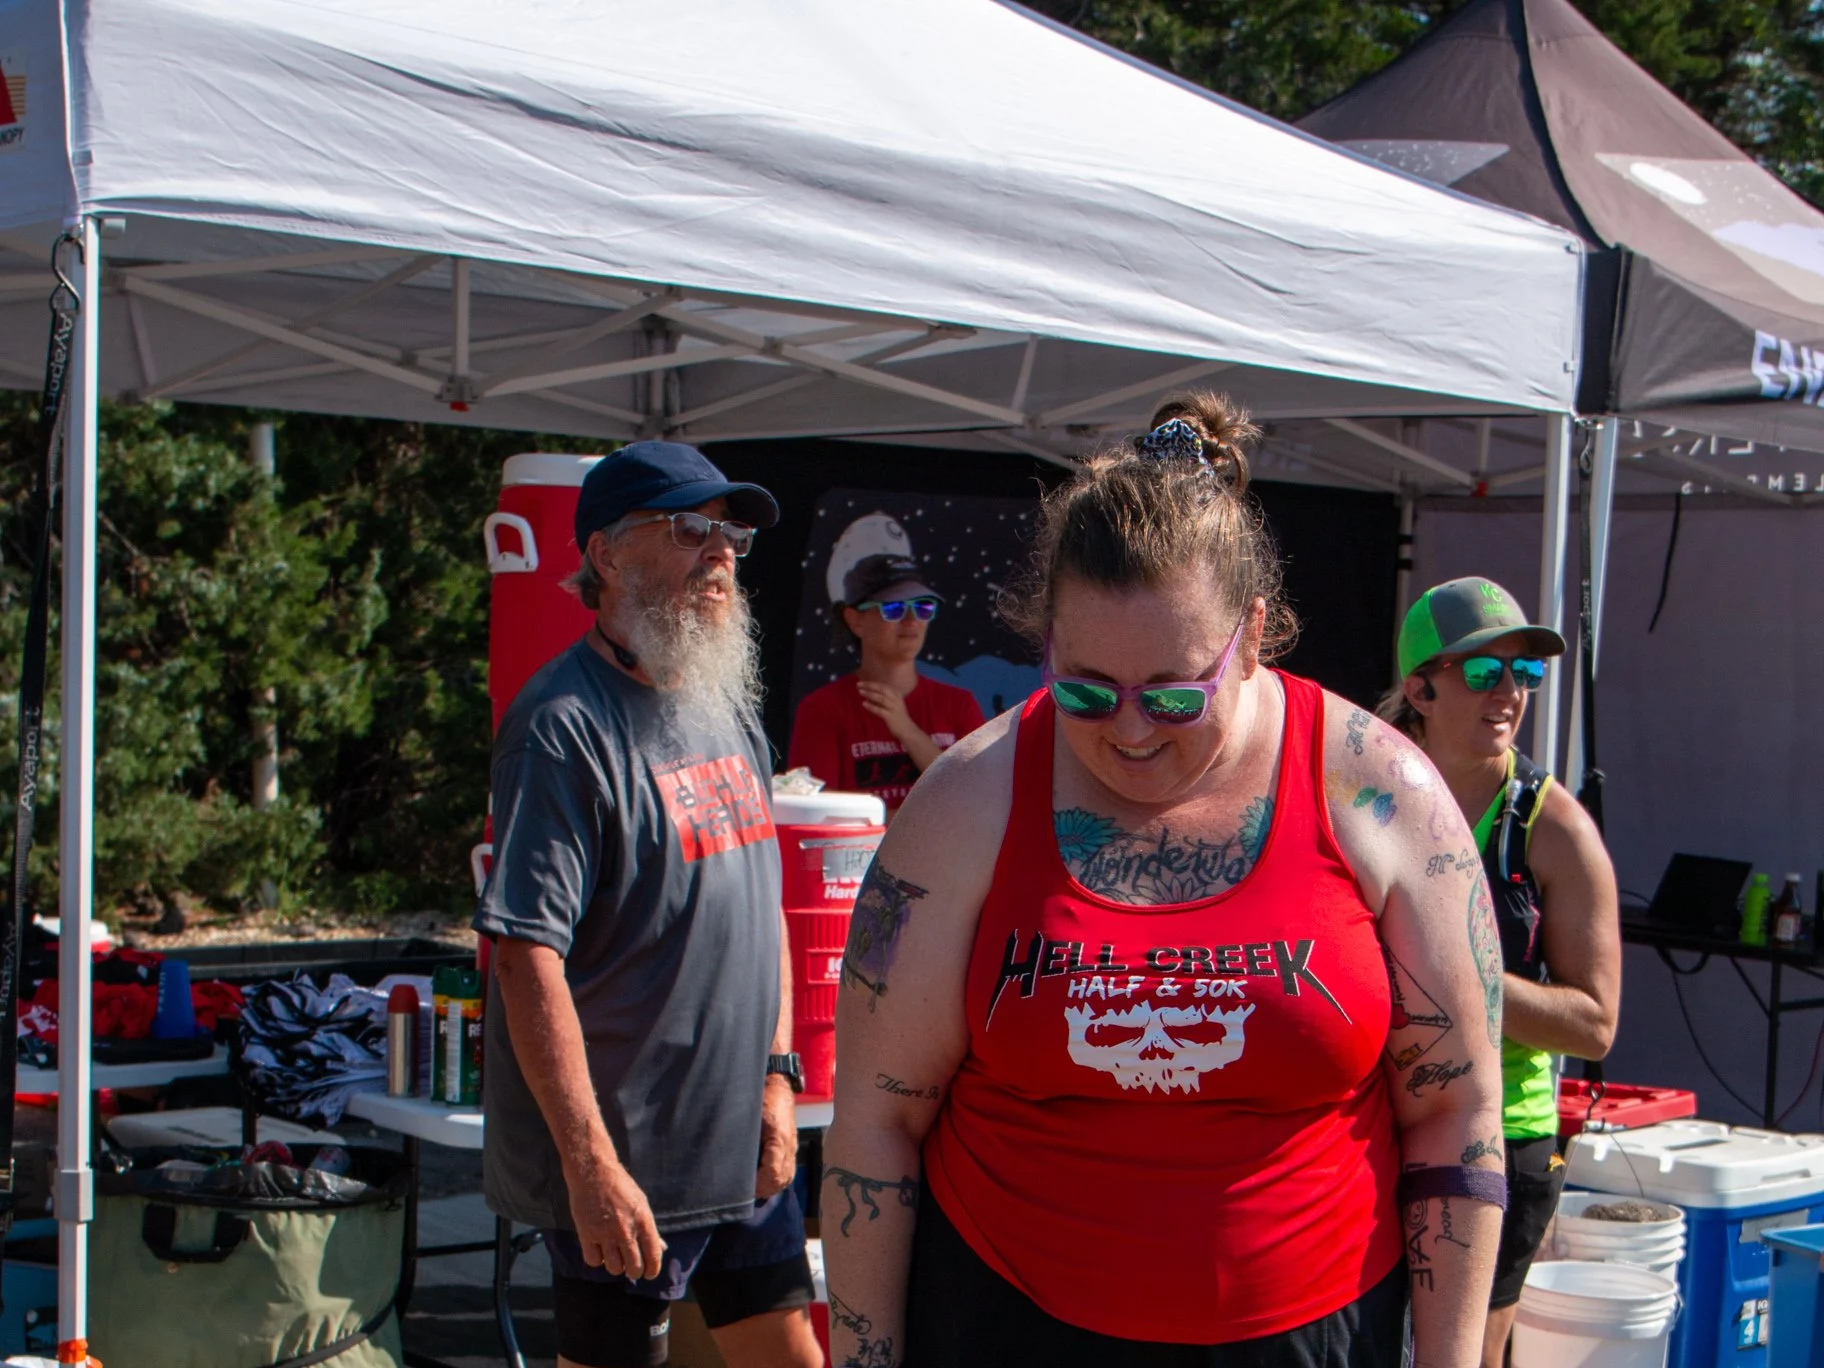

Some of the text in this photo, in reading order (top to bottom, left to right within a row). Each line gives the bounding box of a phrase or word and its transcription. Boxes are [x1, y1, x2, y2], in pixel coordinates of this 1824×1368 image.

[986, 929, 1129, 1032] HELL
[1145, 939, 1352, 1025] CREEK
[1067, 976, 1248, 999] HALF & 50K
